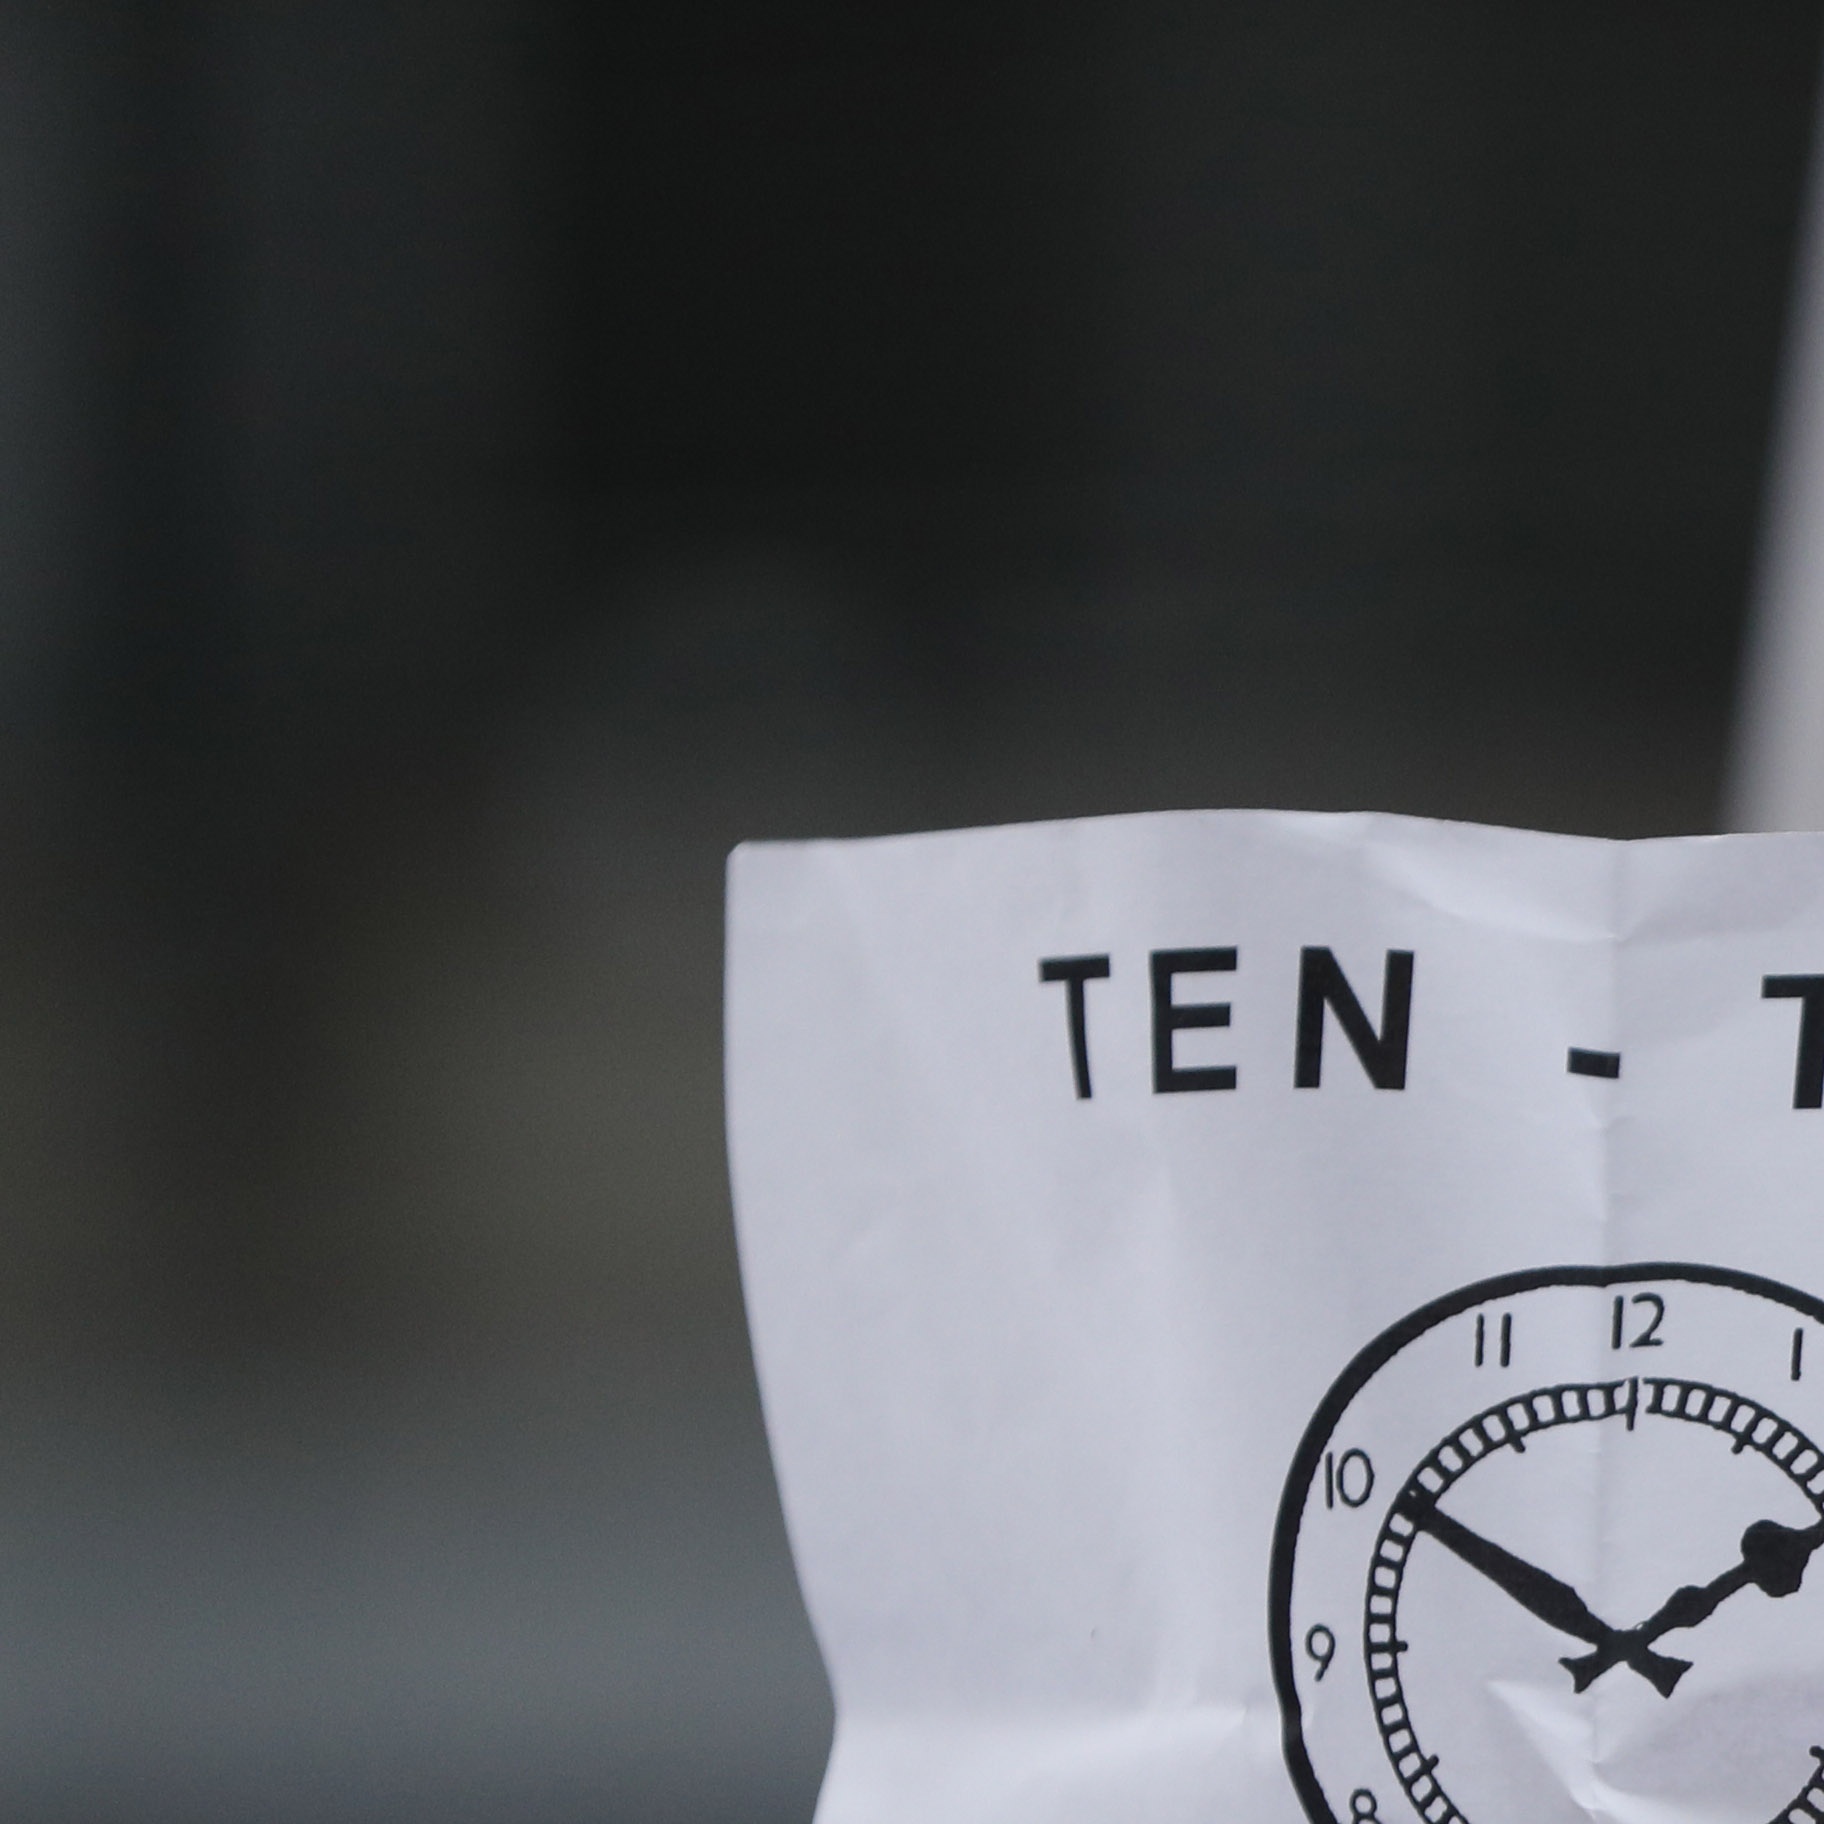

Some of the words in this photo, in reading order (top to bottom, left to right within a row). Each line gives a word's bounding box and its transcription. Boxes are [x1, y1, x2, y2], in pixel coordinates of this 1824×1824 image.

[1037, 944, 1416, 1102] TEN
[1471, 1310, 1515, 1371] 11
[1609, 1290, 1668, 1353] 12
[1788, 1325, 1806, 1384] 1
[1323, 1445, 1378, 1512] 10
[1303, 1621, 1339, 1684] 9
